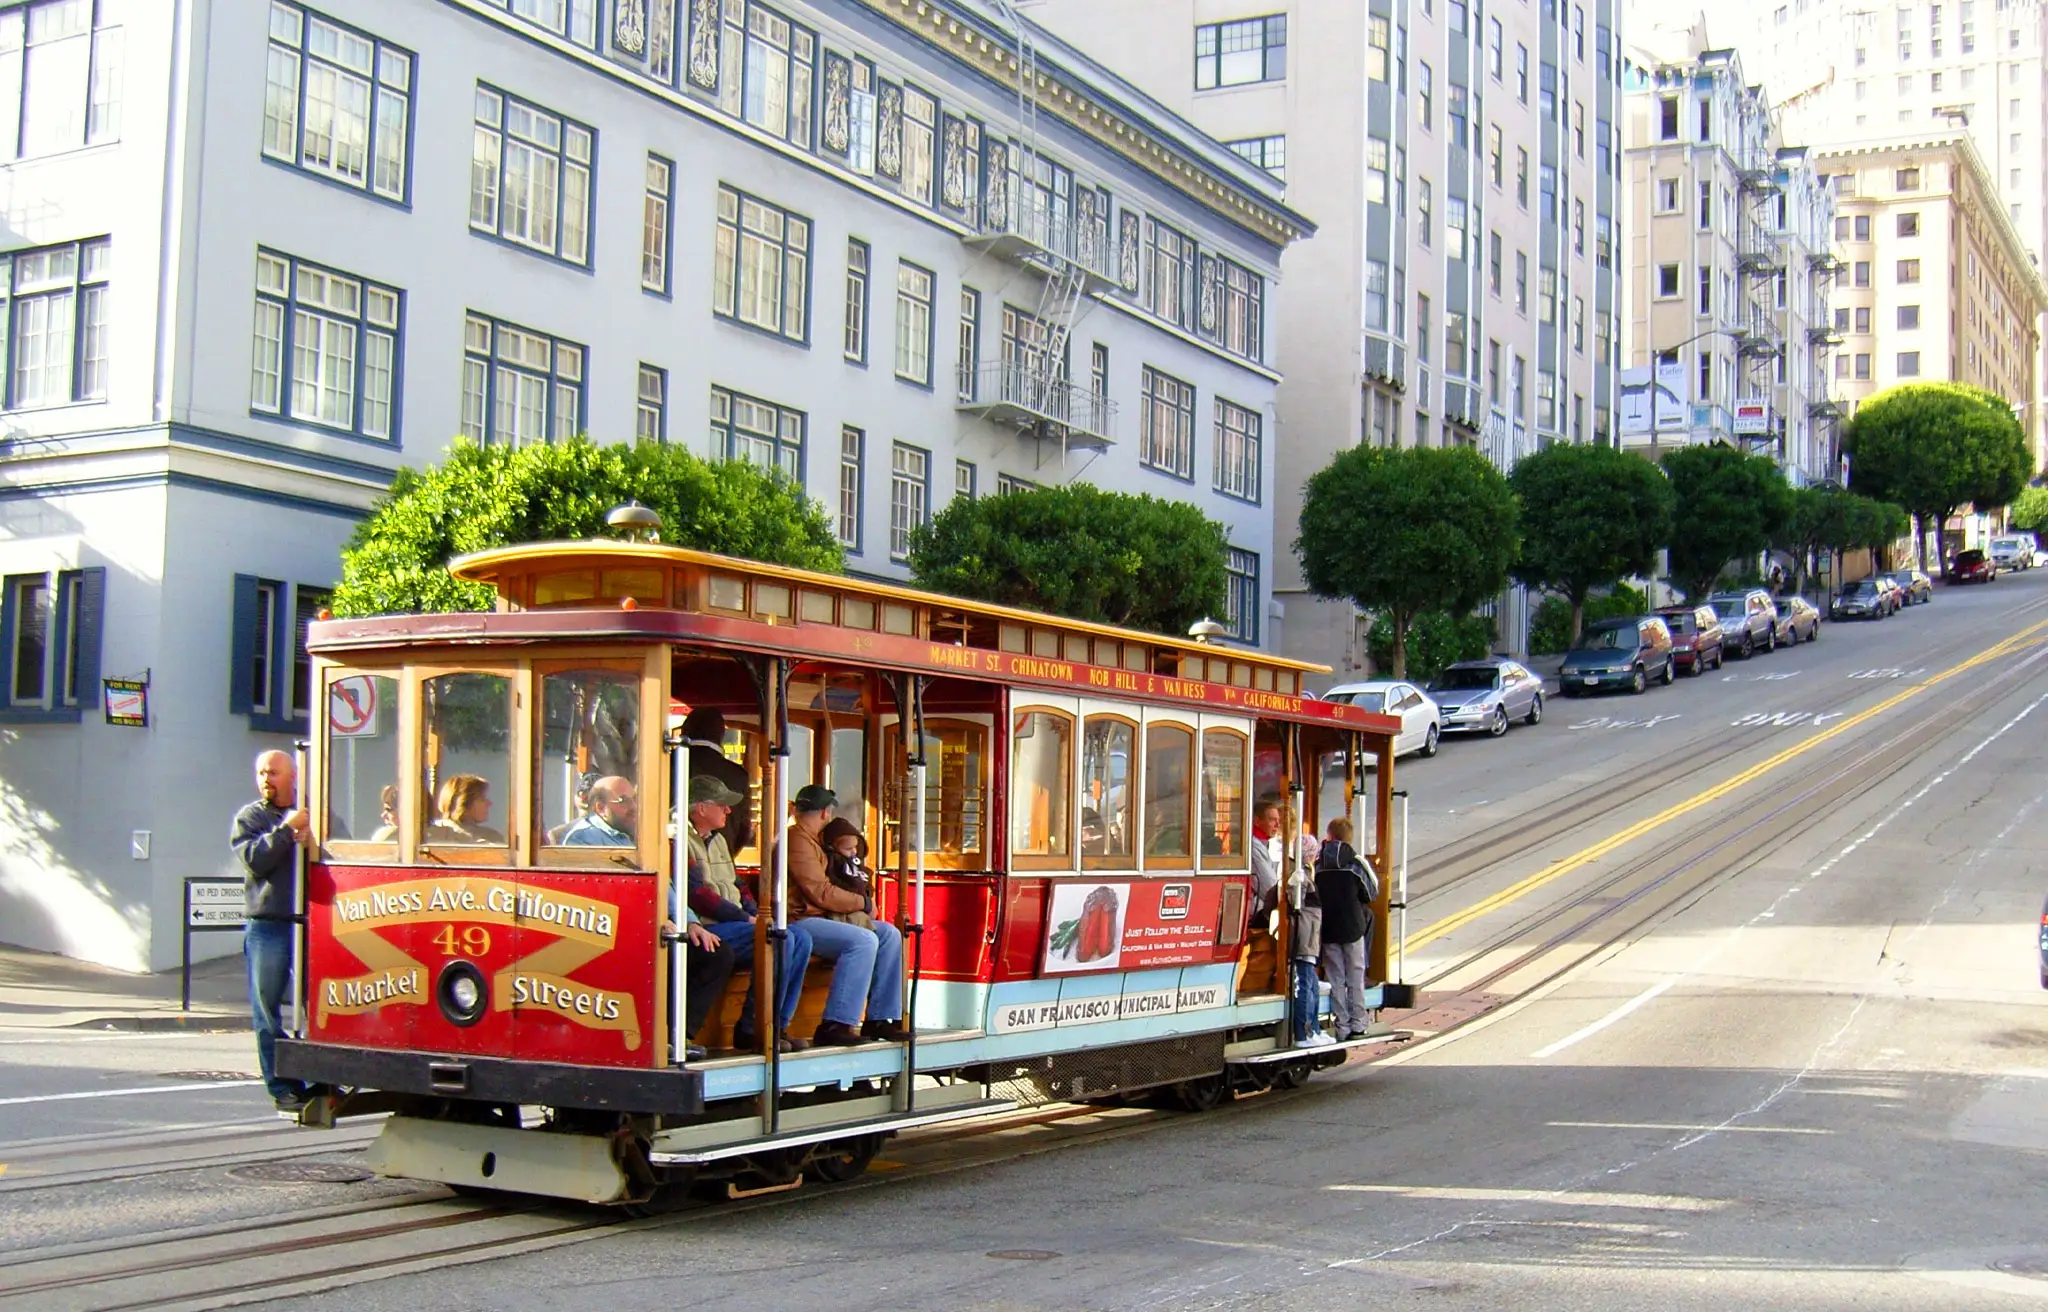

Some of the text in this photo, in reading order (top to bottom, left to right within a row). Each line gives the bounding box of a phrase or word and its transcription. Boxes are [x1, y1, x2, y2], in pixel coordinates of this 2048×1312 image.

[930, 646, 977, 669] MARKET
[1011, 658, 1073, 682] CHINATOWN
[1090, 668, 1109, 687] NOB
[1115, 672, 1137, 690] HILL
[1164, 680, 1181, 697] VAN
[1182, 682, 1206, 699] NESS
[1243, 691, 1291, 711] CALIFORNIA
[1331, 705, 1344, 718] 49
[207, 888, 219, 897] PED
[335, 897, 373, 925] Van
[373, 889, 423, 917] Ness
[488, 884, 614, 937] California
[432, 924, 491, 957] 49
[1145, 927, 1169, 937] FOLLOW
[326, 968, 419, 1007] & Market
[512, 975, 621, 1021] Streets
[1007, 988, 1217, 1028] SAN FRANCISCO MUNICIPAL RAILWAY
